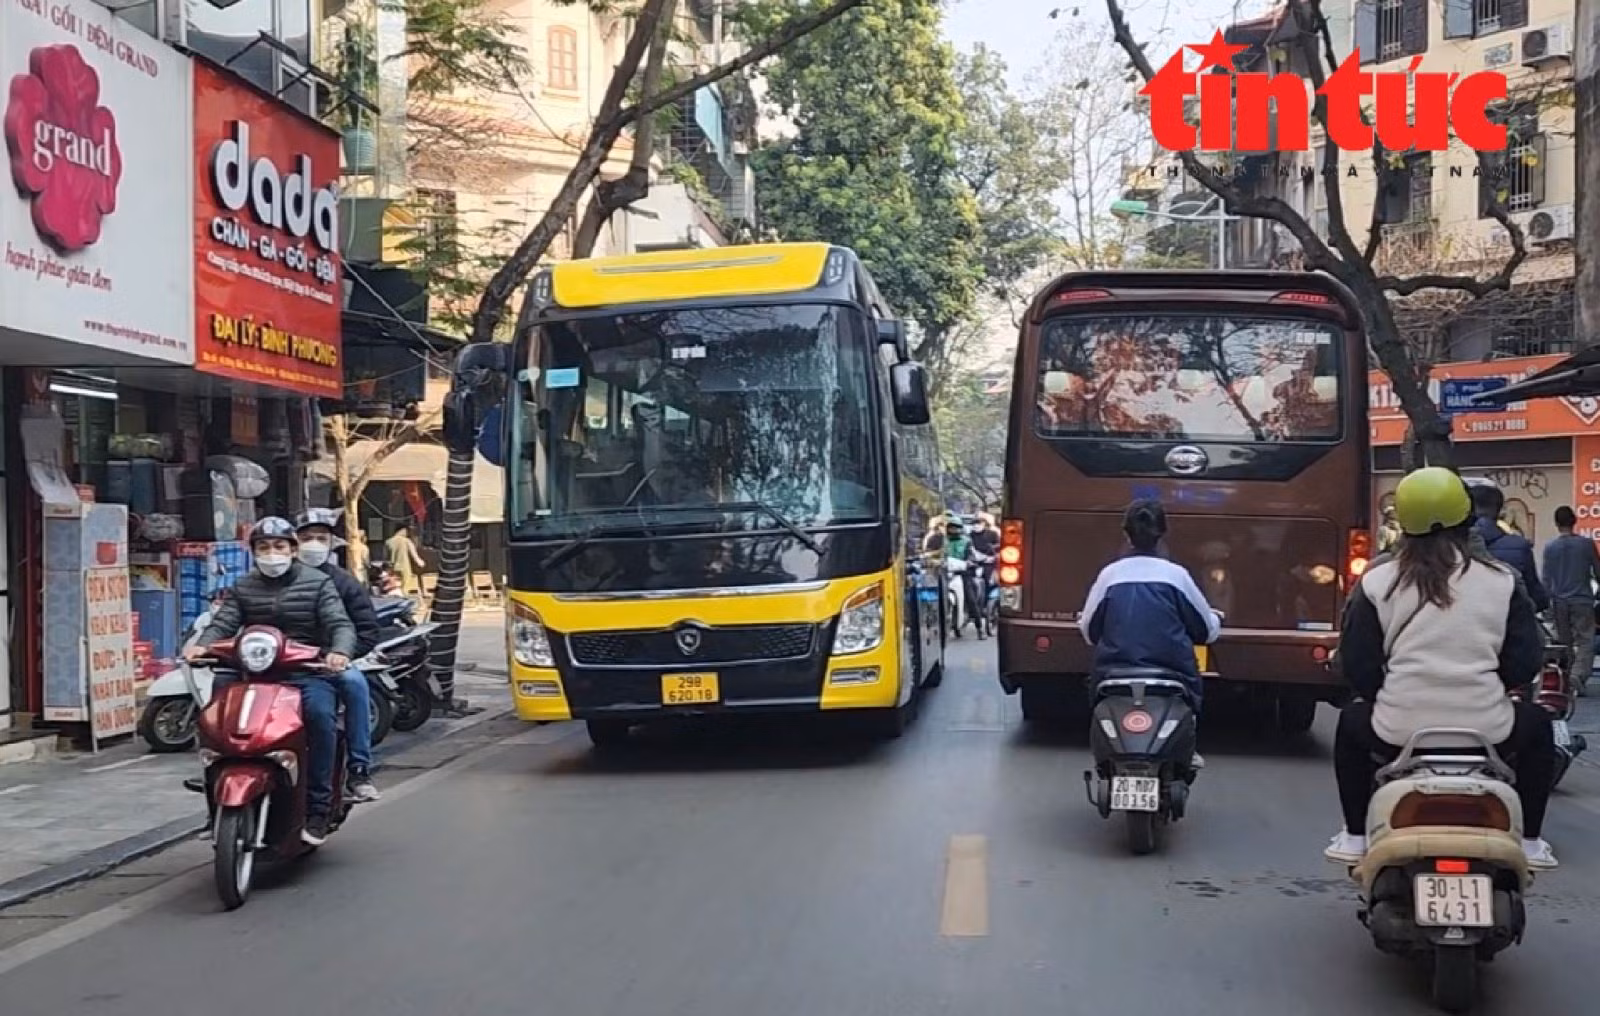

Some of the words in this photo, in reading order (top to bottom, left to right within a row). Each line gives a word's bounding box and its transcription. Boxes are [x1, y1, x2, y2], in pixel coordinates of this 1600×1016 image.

[116, 41, 158, 78] GRAND
[34, 119, 112, 176] grand
[215, 119, 338, 251] dada
[260, 235, 278, 261] GA
[213, 313, 238, 348] ĐẠI
[261, 320, 289, 355] BÌNH
[1428, 901, 1480, 922] 6431
